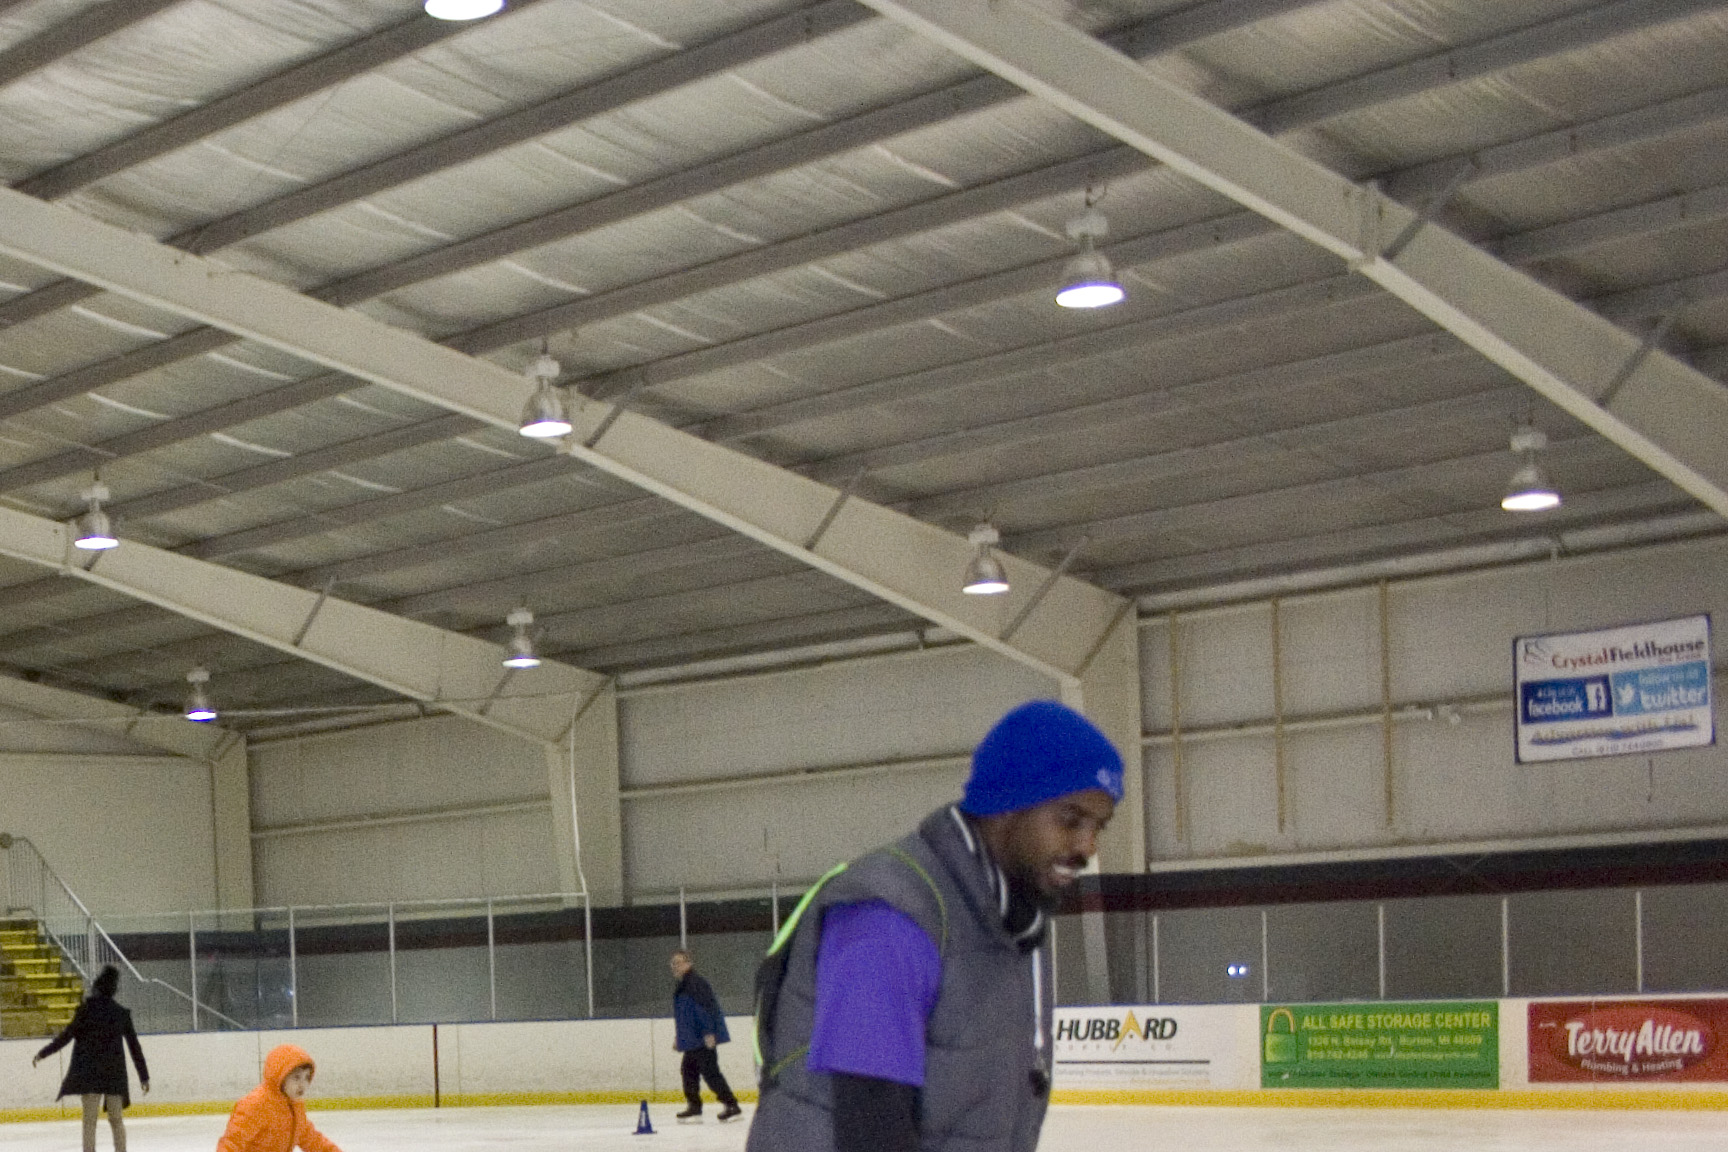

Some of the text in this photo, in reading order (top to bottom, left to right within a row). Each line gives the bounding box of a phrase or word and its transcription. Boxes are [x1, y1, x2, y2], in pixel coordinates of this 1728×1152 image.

[1528, 696, 1584, 717] facebook
[1640, 686, 1706, 709] twitter
[1056, 1009, 1178, 1051] HUBBARD
[1302, 1012, 1491, 1030] ALL SAFE STORAGE CENTER
[1581, 1059, 1629, 1075] Plumbing
[1642, 1059, 1683, 1072] Heating
